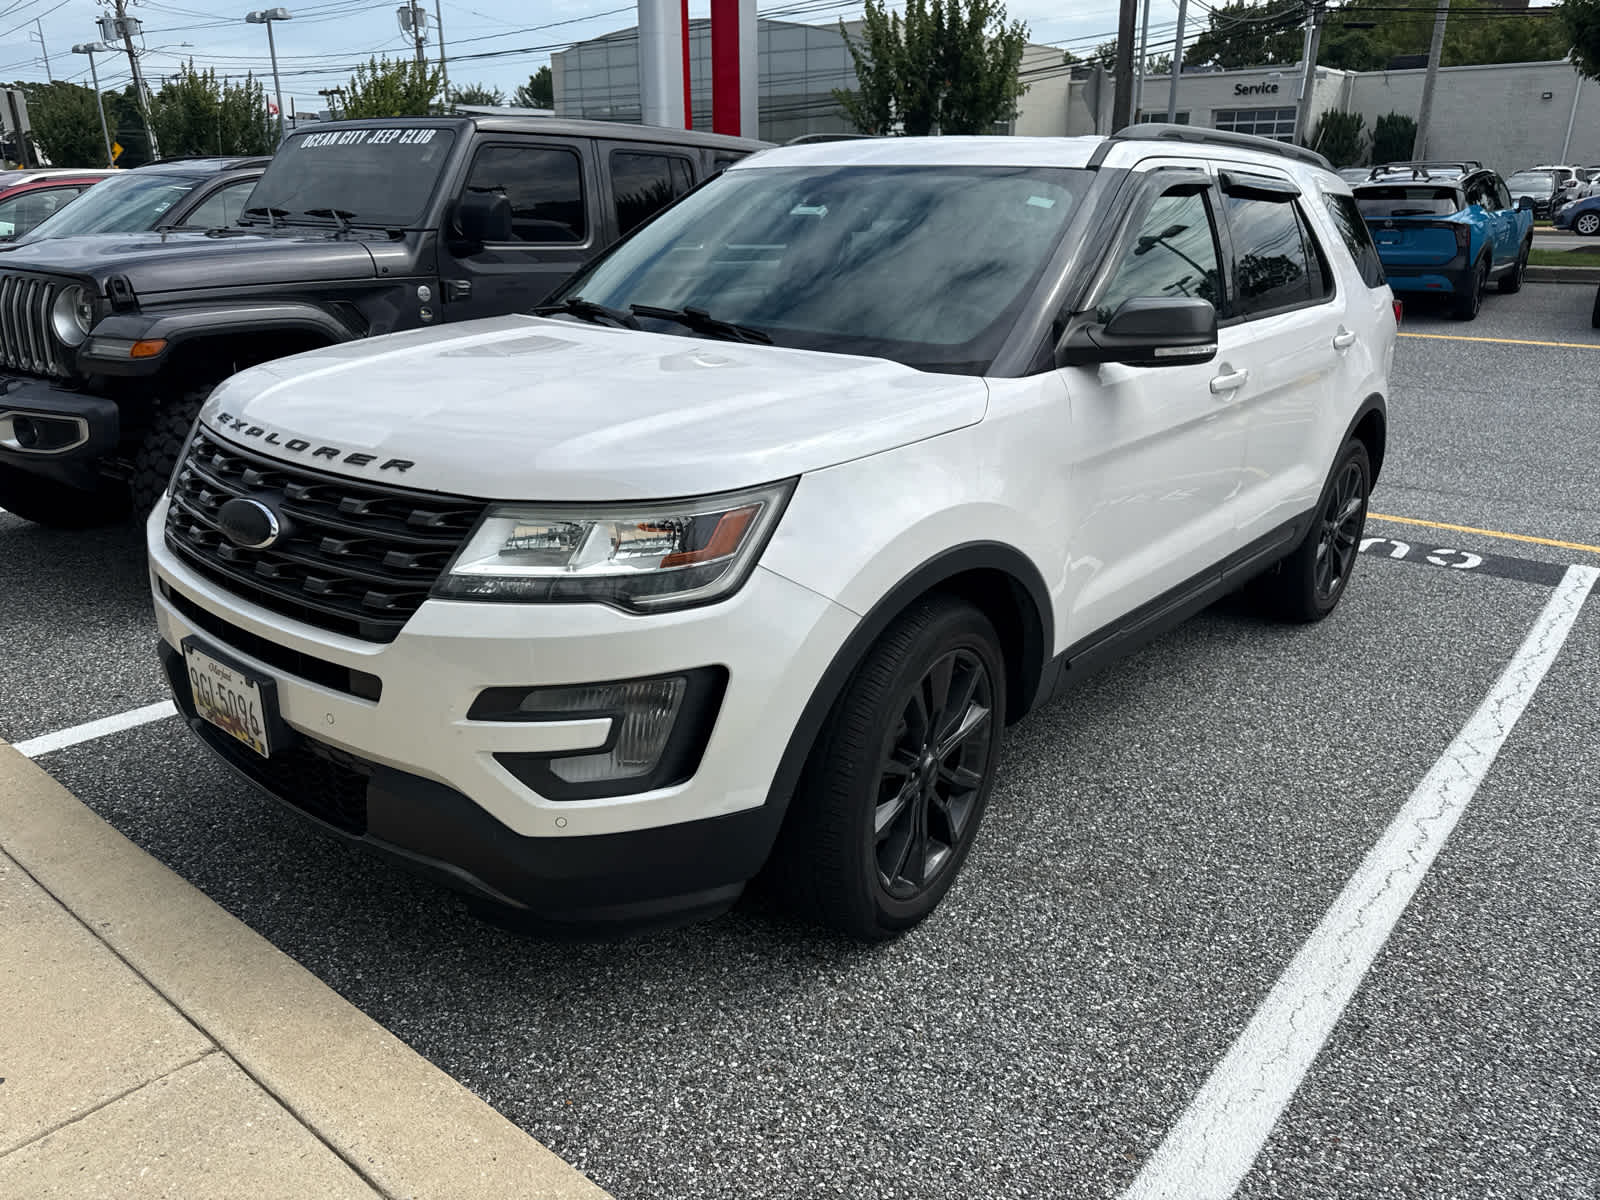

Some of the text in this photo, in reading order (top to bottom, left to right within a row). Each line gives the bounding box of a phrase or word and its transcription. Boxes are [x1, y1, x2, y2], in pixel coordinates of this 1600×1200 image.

[1234, 81, 1279, 96] Service
[300, 129, 437, 149] OCEAN CITY JEEP CLUB
[216, 412, 416, 473] EXPLORER
